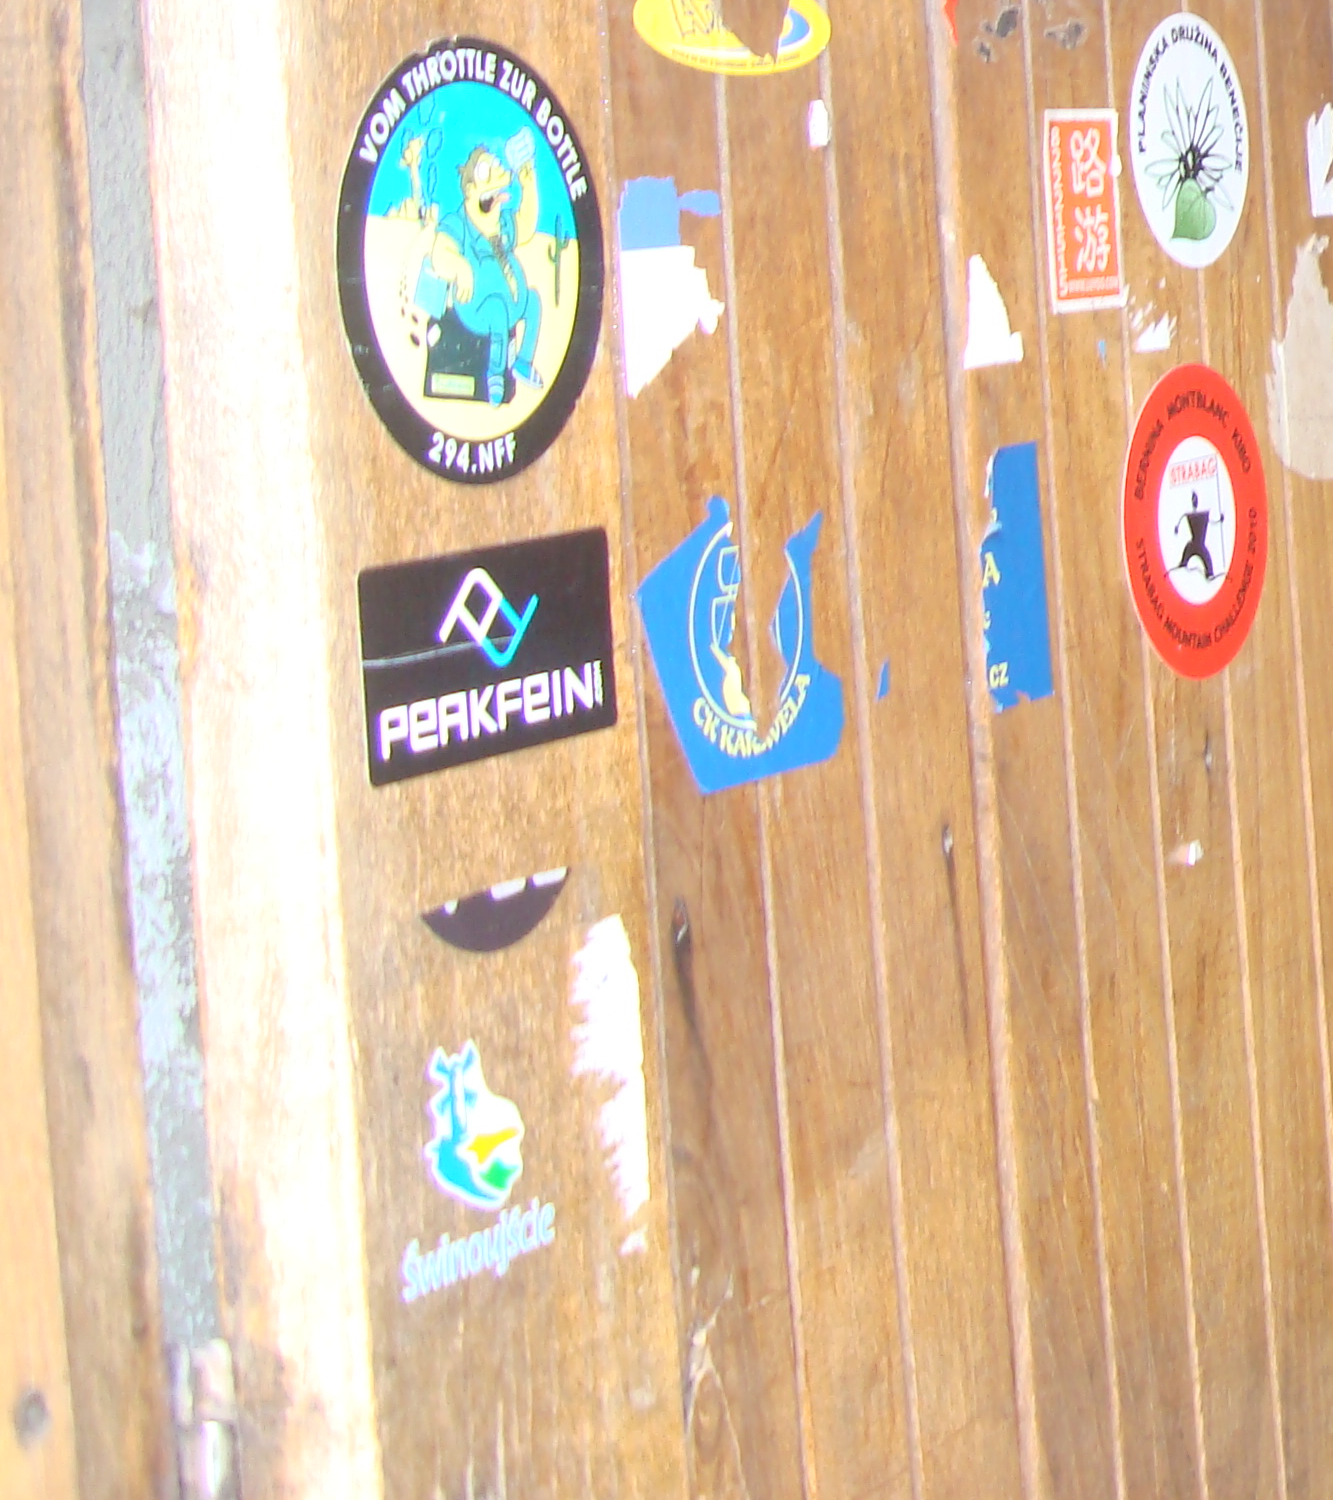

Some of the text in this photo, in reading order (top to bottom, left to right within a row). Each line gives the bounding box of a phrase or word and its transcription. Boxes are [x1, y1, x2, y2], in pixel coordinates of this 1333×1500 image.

[359, 47, 588, 202] VOM THROTTLE ZUR BOTTLE
[428, 431, 517, 475] 294.NFF
[1169, 457, 1217, 485] STRABAG
